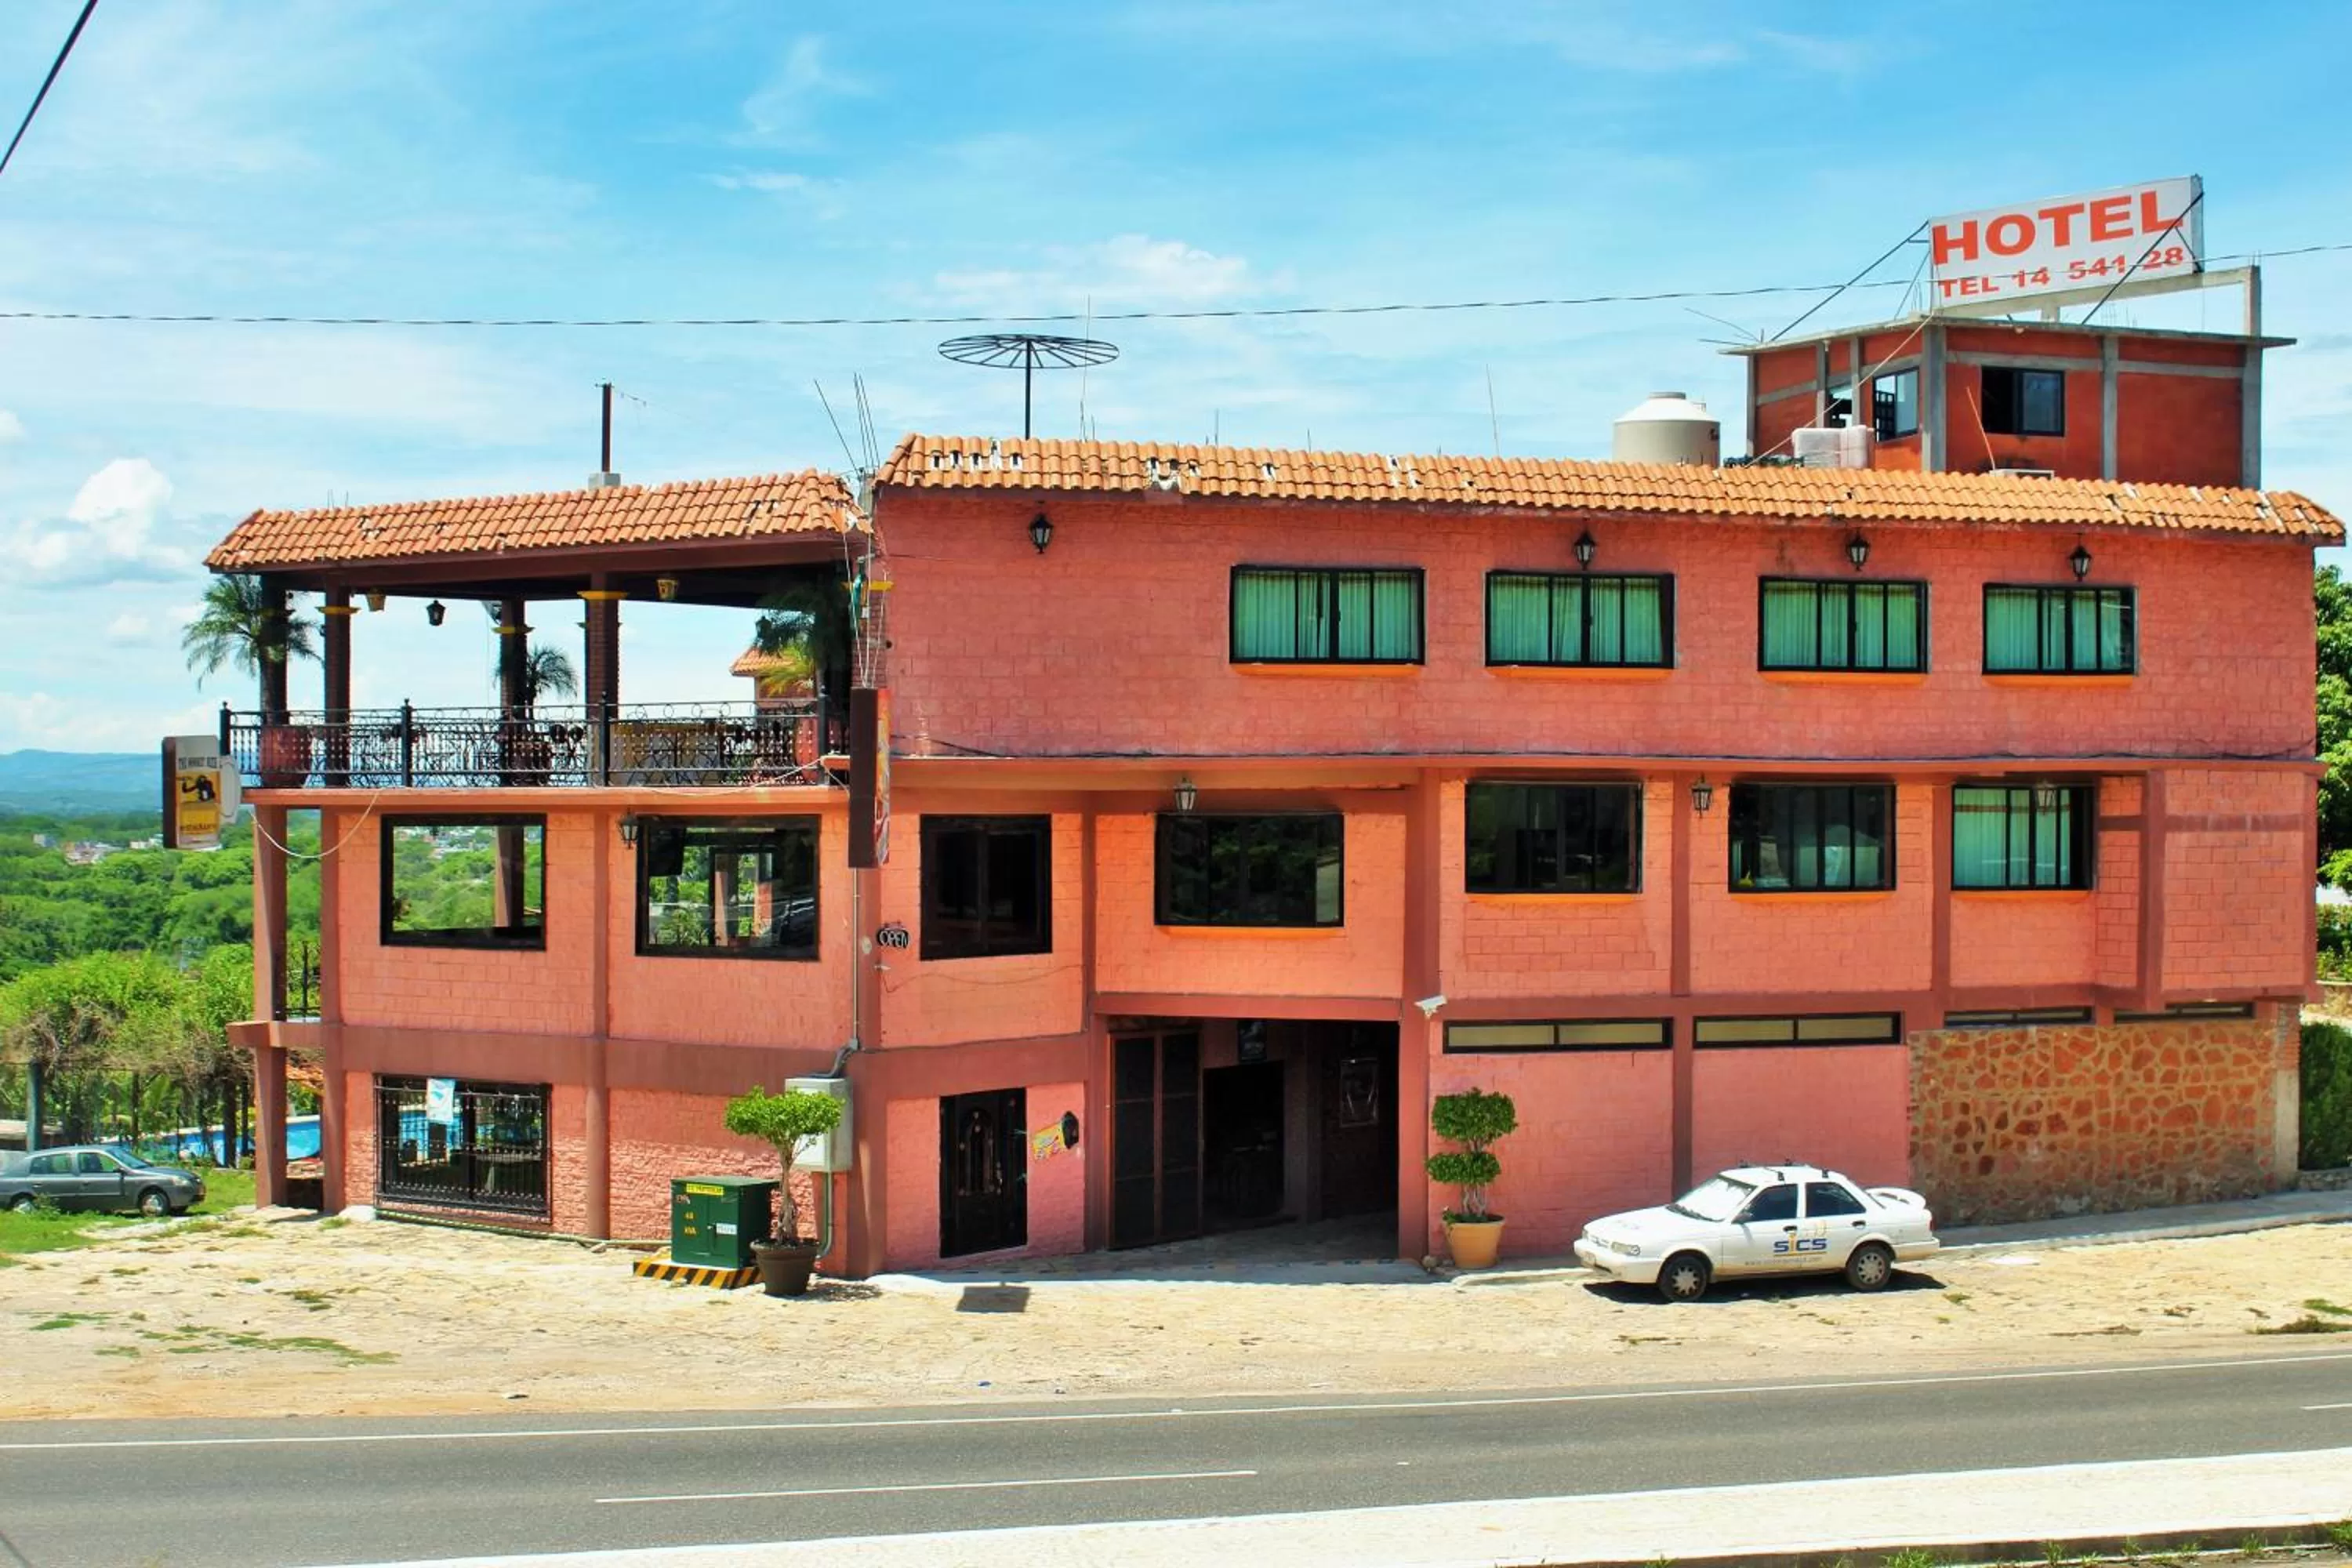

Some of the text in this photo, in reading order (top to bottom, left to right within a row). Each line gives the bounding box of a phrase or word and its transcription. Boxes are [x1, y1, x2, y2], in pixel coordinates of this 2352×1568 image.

[1932, 190, 2184, 266] HOTEL
[1939, 246, 2184, 298] TEL 14 541 28
[879, 931, 908, 948] OPEN
